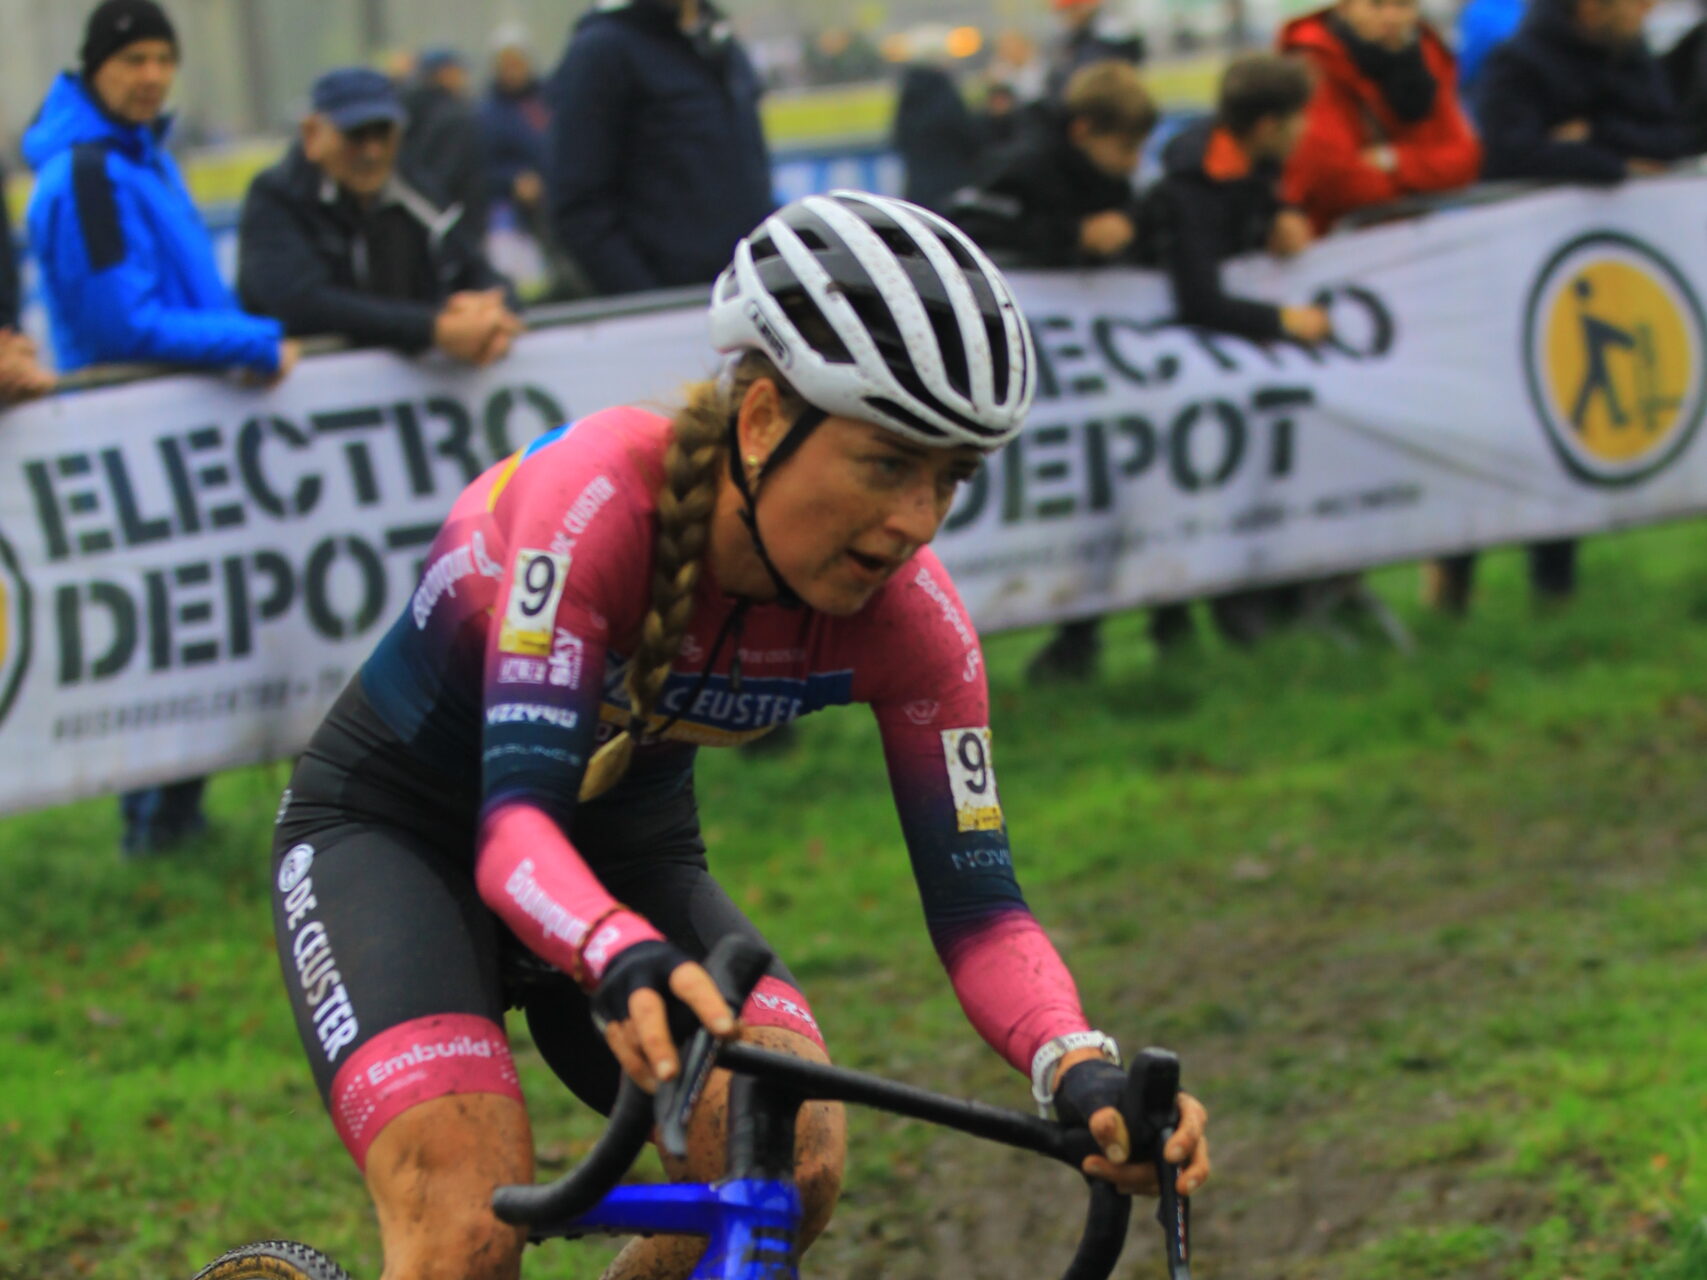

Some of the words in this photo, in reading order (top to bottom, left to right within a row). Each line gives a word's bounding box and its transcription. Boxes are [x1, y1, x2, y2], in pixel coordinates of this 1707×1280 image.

[520, 555, 556, 617] 9
[957, 731, 987, 795] 9
[284, 876, 318, 931] DE
[293, 920, 360, 1064] CEUSTER
[366, 1036, 493, 1086] Embuild
